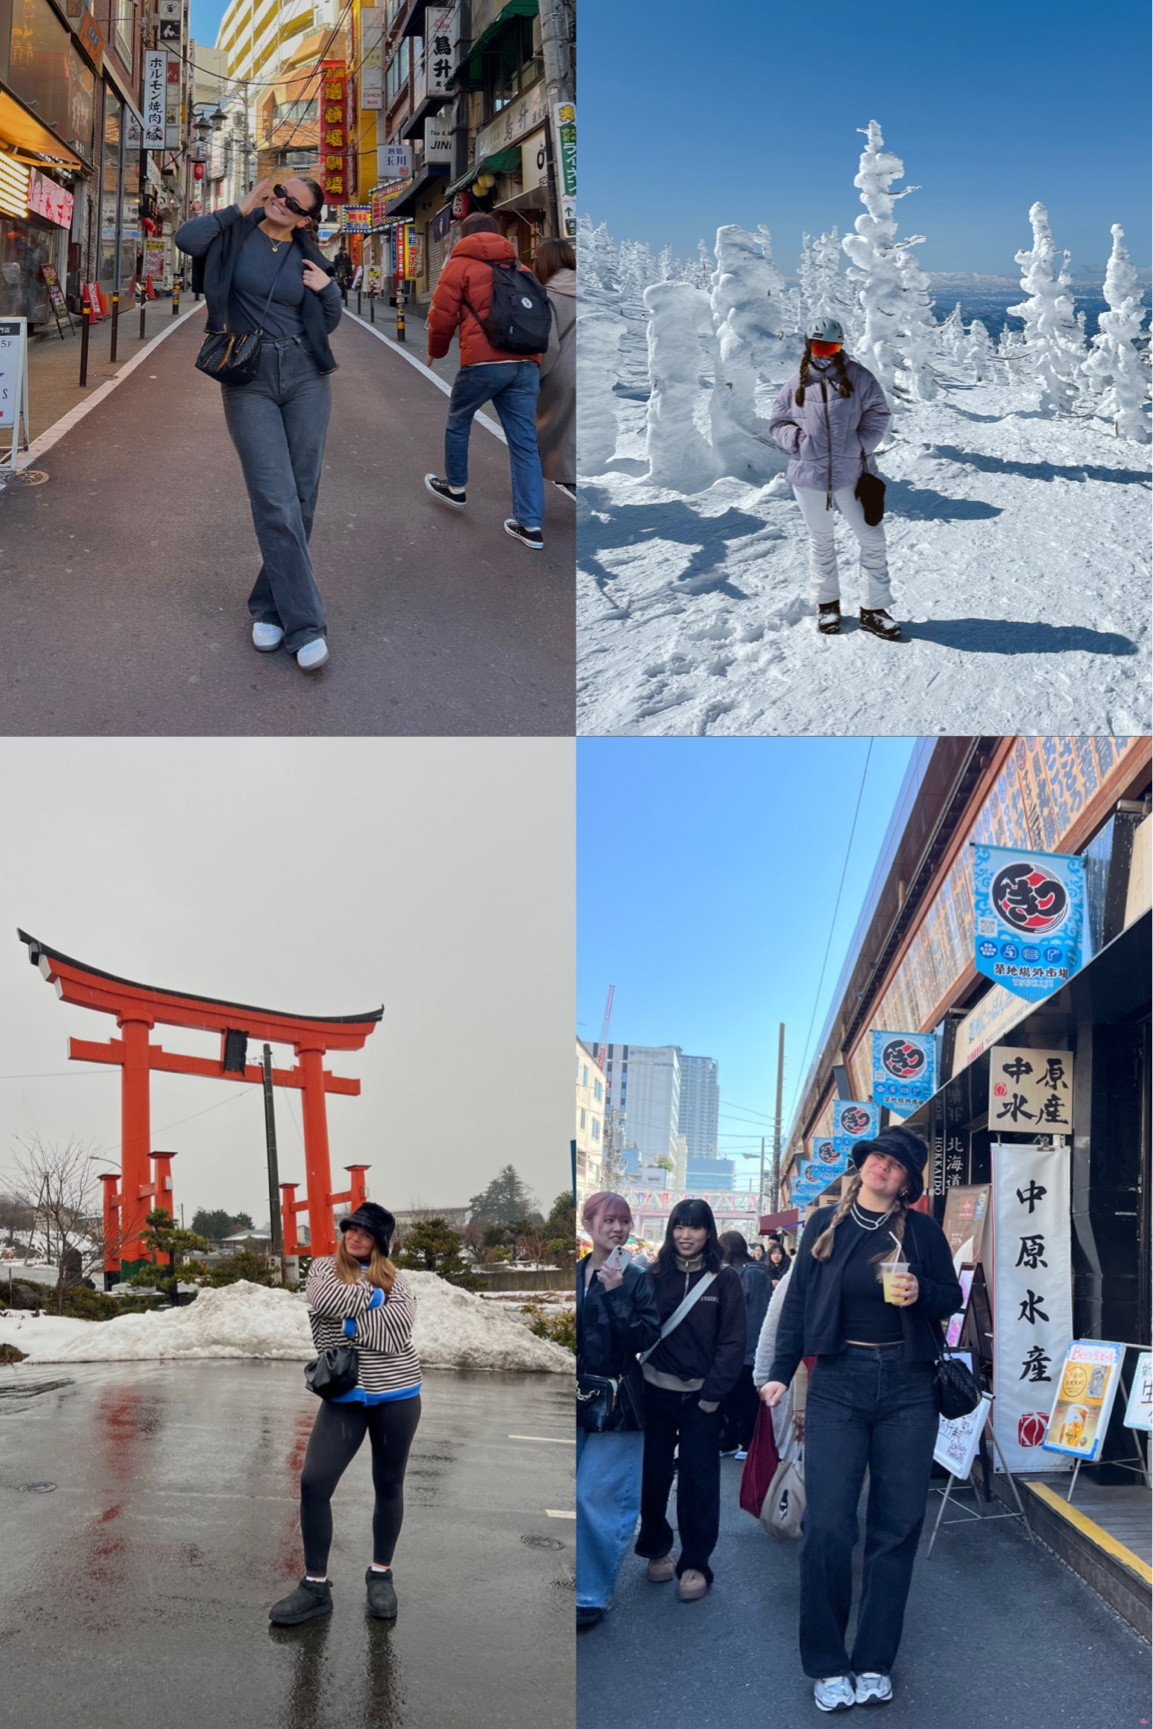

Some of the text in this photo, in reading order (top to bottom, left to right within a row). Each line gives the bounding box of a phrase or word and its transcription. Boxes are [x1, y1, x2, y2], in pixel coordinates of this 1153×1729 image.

[934, 1136, 943, 1196] HOKKAIDO
[1015, 1180, 1052, 1383] 中原水産
